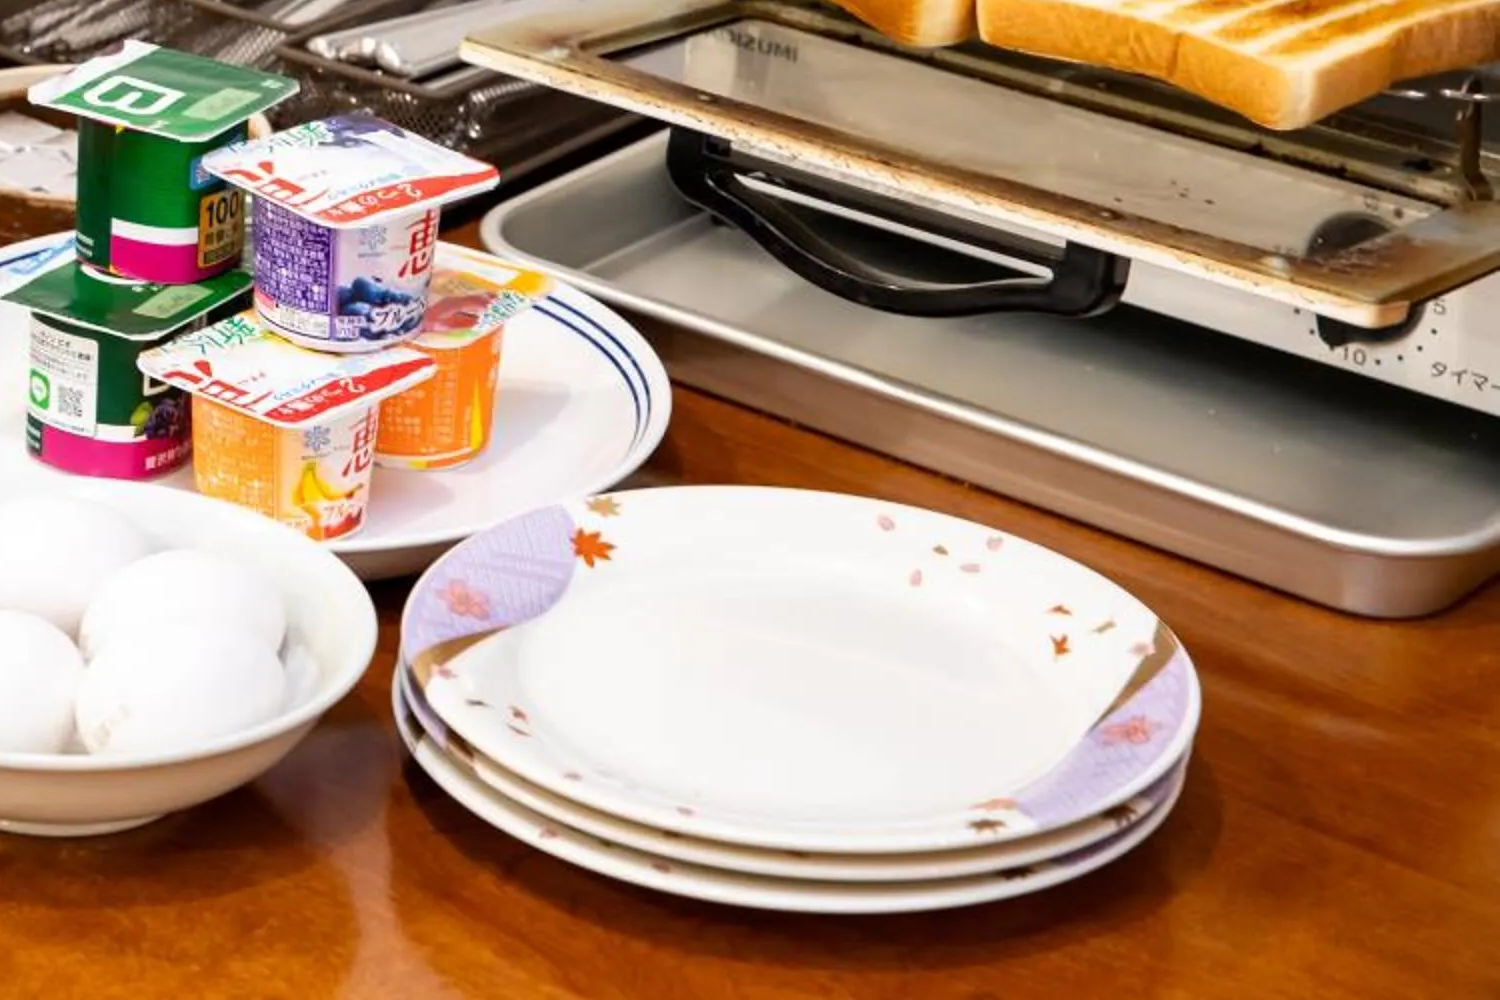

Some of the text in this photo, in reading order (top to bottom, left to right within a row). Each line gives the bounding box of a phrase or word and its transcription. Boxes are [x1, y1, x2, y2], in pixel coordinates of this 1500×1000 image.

[206, 190, 240, 229] 100
[1342, 346, 1367, 366] 10
[1431, 361, 1500, 391] タイマー
